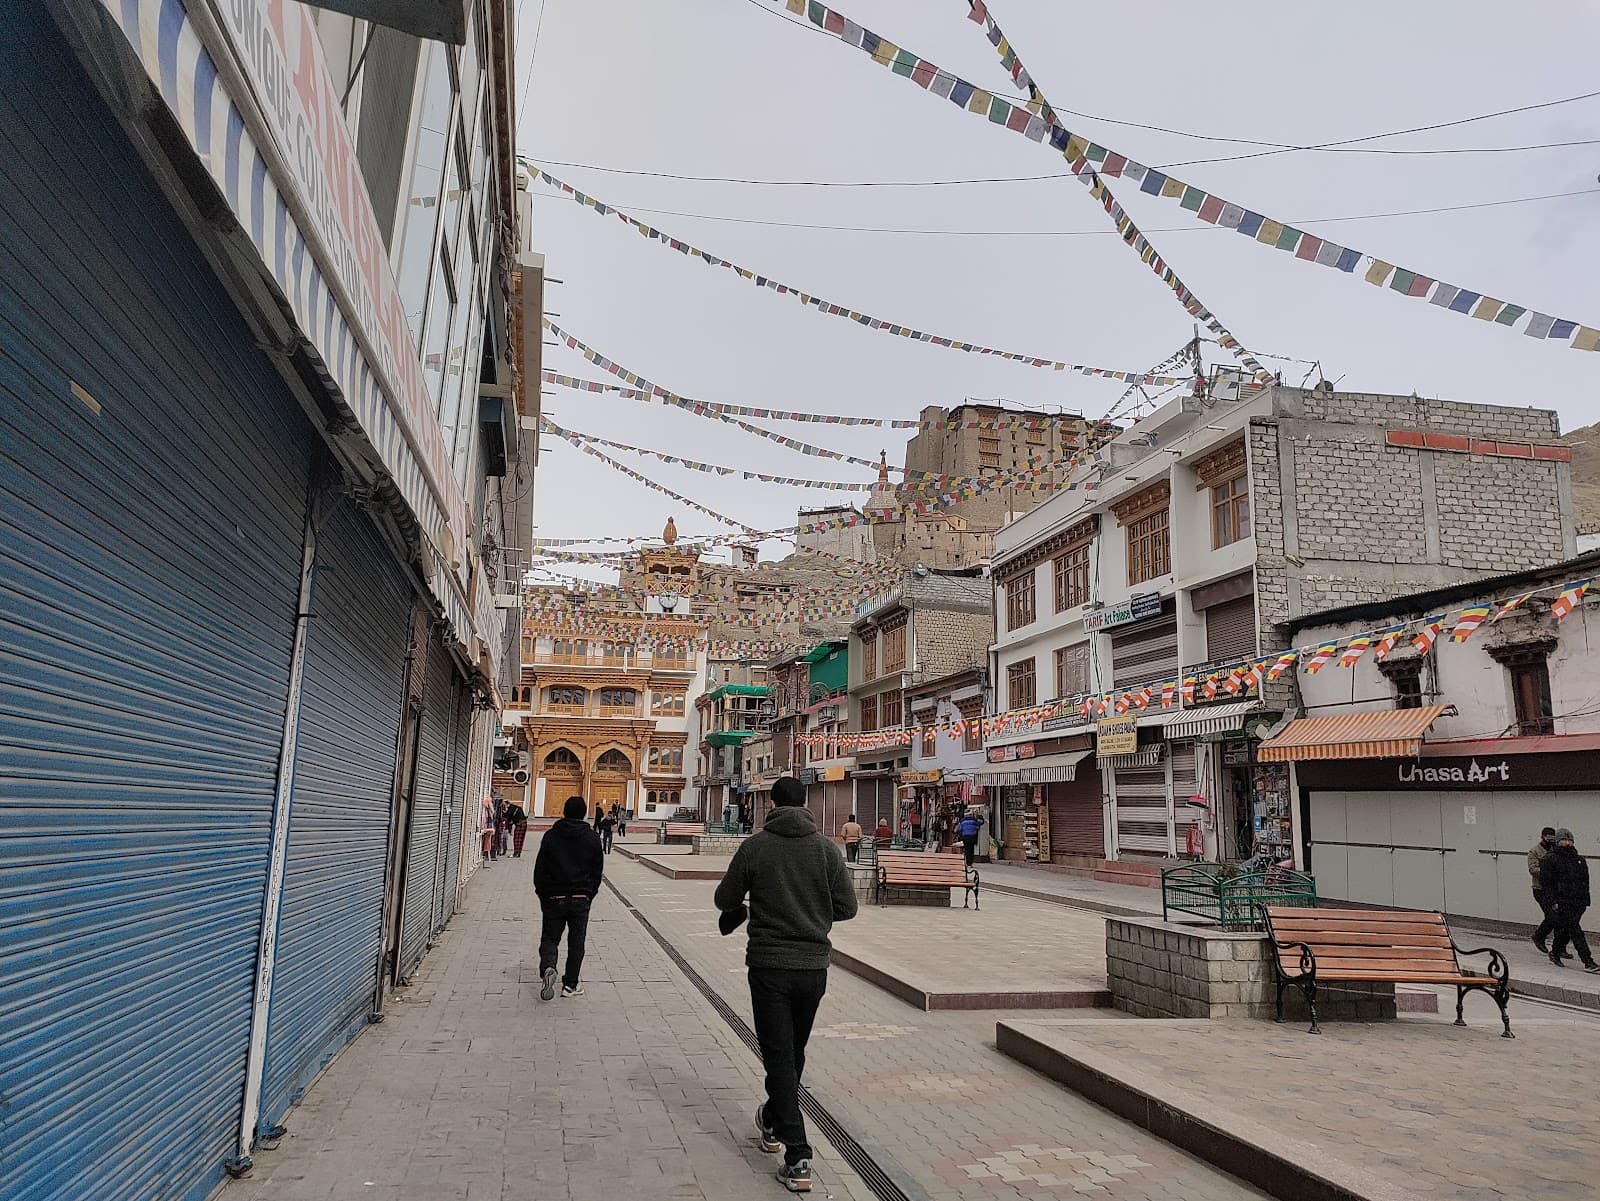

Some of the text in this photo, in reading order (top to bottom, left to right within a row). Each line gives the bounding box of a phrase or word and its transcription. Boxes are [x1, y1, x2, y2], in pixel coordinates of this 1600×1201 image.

[297, 110, 362, 316] COLLECTION
[1084, 614, 1103, 630] TARIF
[1104, 612, 1112, 625] Art
[1398, 758, 1510, 783] Lhasa Art
